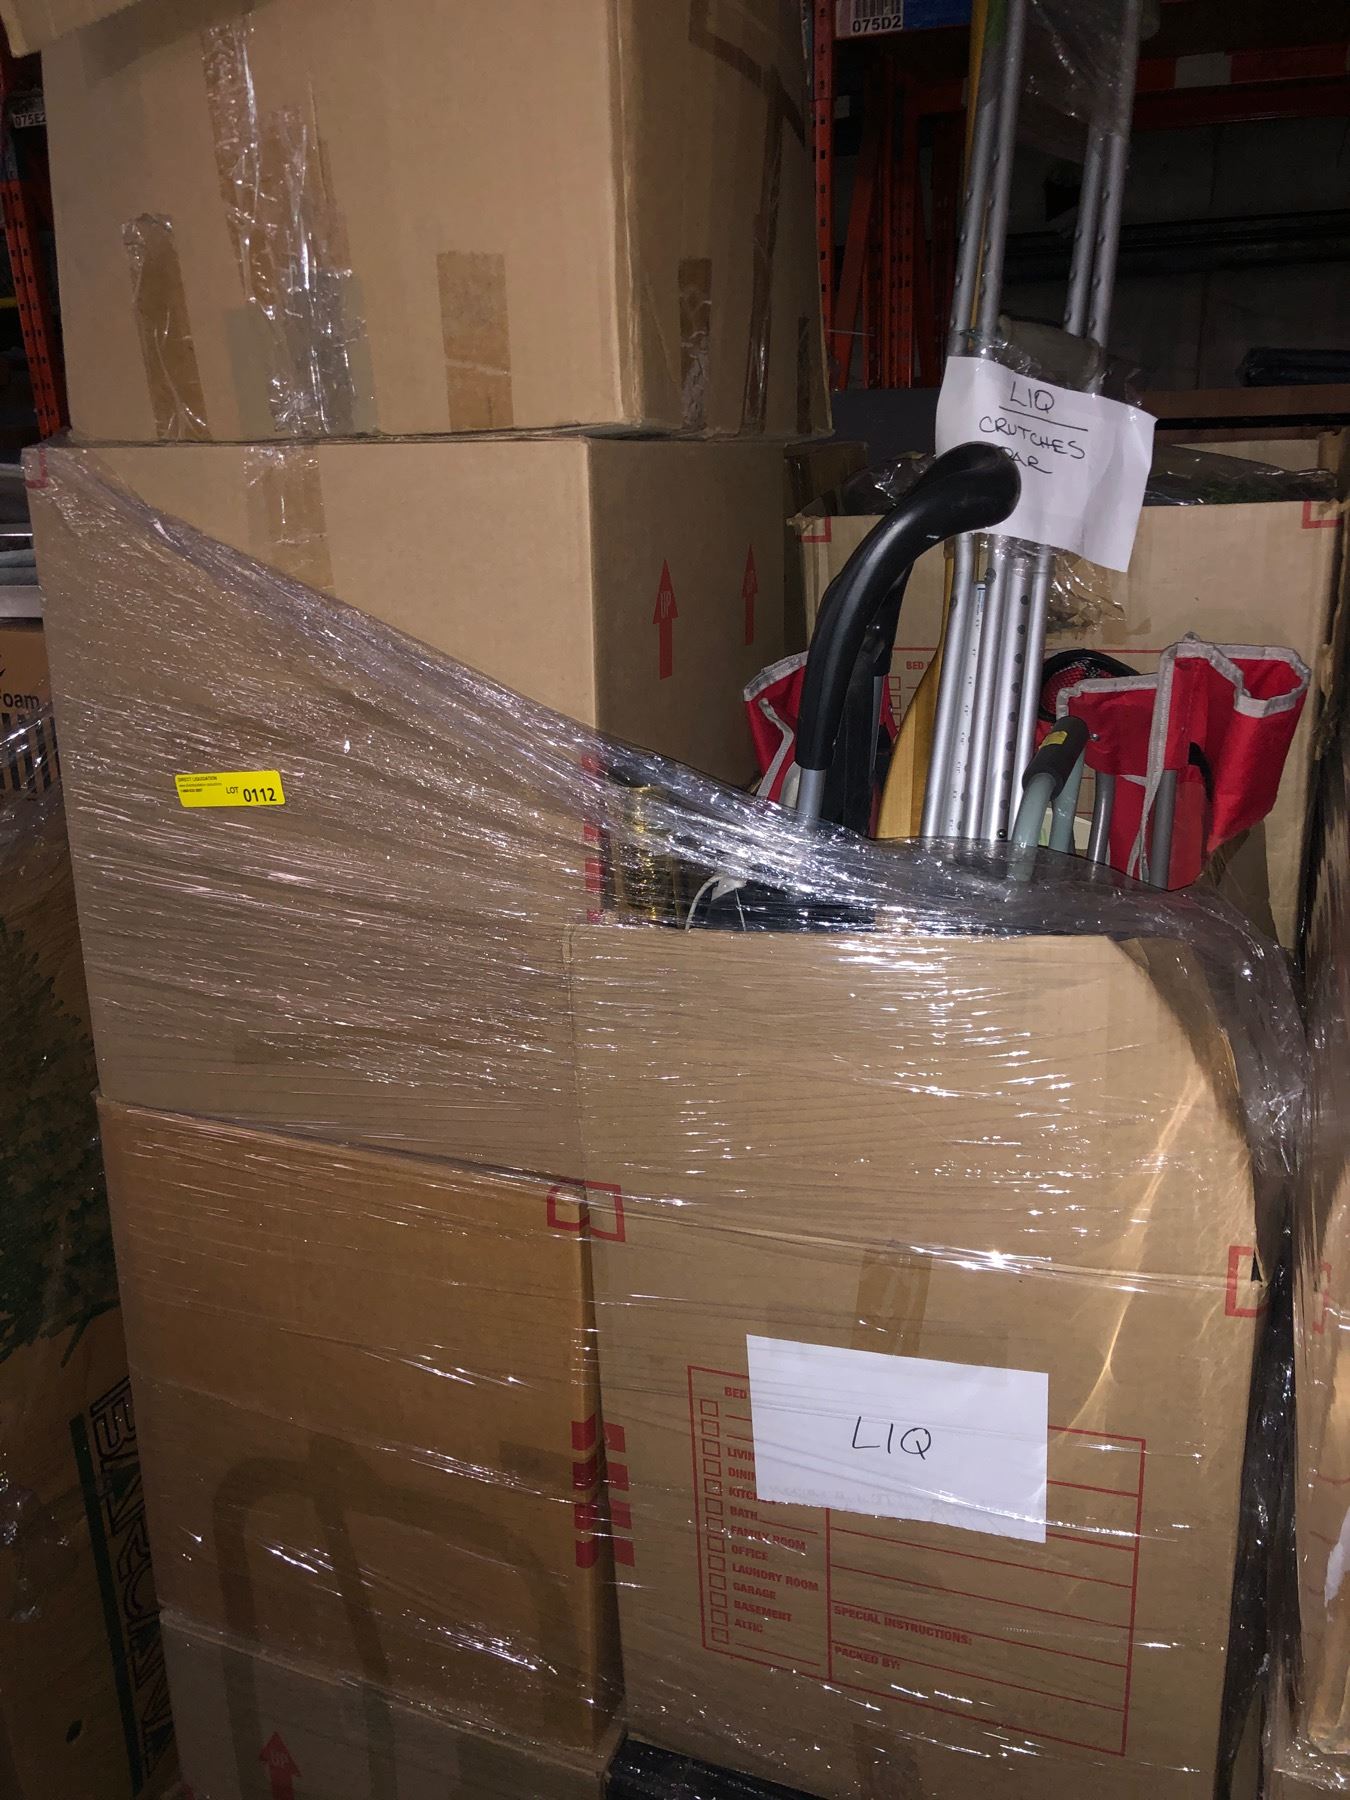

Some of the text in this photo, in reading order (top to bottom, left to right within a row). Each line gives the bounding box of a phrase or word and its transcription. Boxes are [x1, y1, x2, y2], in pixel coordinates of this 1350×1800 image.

[852, 15, 901, 33] 075D2
[1010, 382, 1054, 413] LIQ
[979, 416, 1085, 459] CRUTCHES
[906, 661, 924, 670] BED
[0, 689, 40, 710] oam
[243, 787, 277, 803] 0112
[724, 1387, 747, 1400] BED
[852, 1416, 932, 1460] LIQ
[730, 1506, 758, 1520] BATH
[731, 1525, 806, 1552] FAMILY ROOM
[731, 1544, 769, 1561] OFFICE
[732, 1563, 819, 1592] LAUNDRY ROOM
[733, 1582, 776, 1600] GARAGE
[734, 1600, 792, 1622] BASEMENT
[734, 1618, 763, 1633] ATTIC
[834, 1605, 972, 1646] SPECIAL INSTRUCTIONS:
[834, 1646, 900, 1671] PACKED BY:
